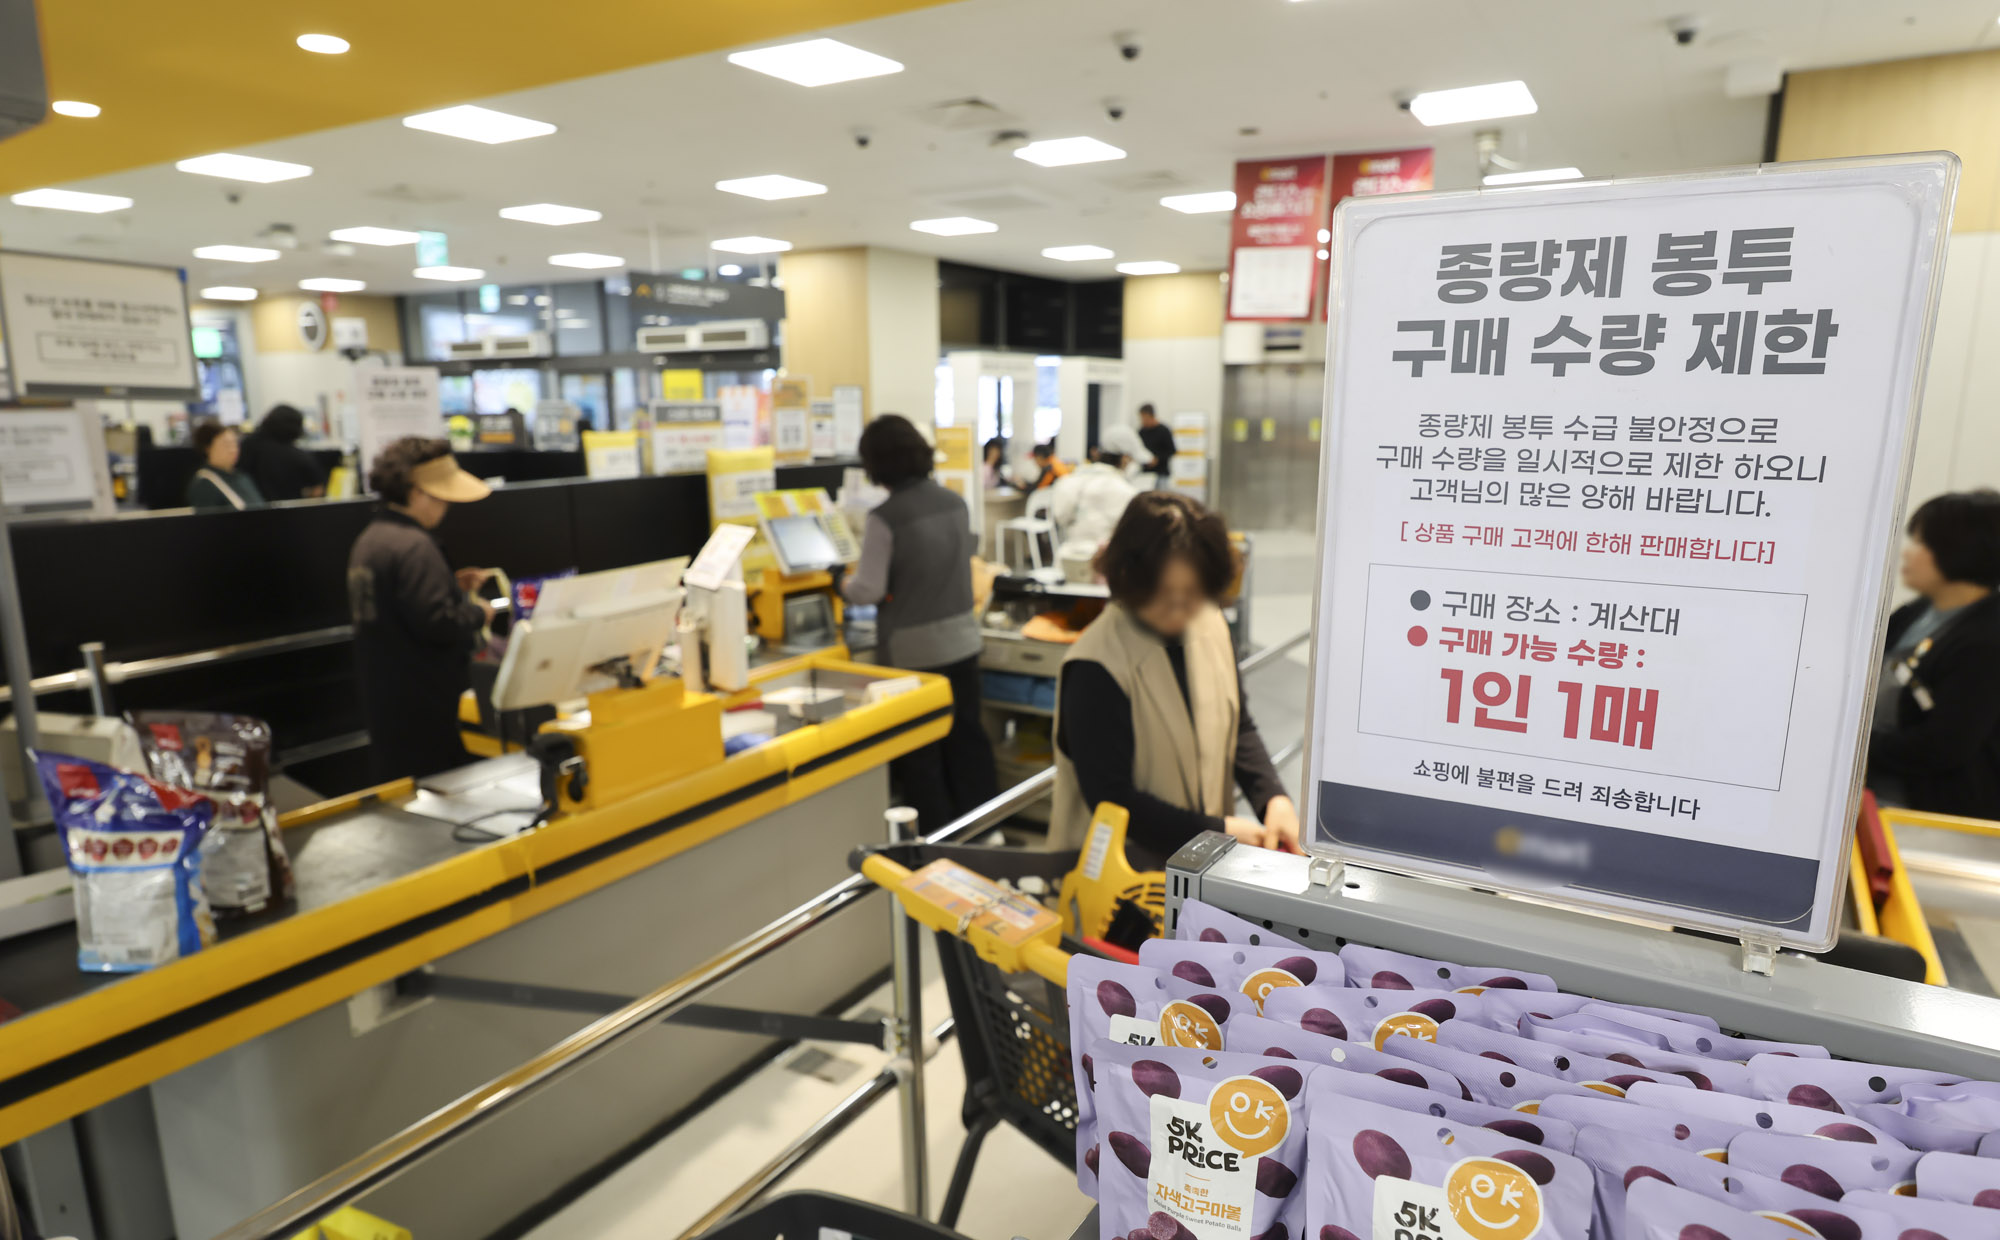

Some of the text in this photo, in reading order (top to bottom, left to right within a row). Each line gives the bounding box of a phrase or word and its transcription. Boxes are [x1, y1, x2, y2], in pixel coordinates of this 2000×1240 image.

[1437, 227, 1794, 304] 종량제 봉투
[1392, 309, 1839, 377] 구매 수량 제한
[1419, 414, 1778, 443] 종량제 봉투 수급 불안정으로
[1377, 446, 1826, 482] 구매 수량을 일시적으로 제한 하오니
[1411, 479, 1770, 517] 고객님의 많은 양해 바랍니다.
[1415, 523, 1455, 544] 상품
[1462, 525, 1504, 547] 구매
[1511, 528, 1578, 552] 고객에
[1586, 532, 1632, 555] 한해
[1640, 535, 1776, 565] 판매합니다]
[1442, 590, 1496, 620] 구매
[1506, 595, 1560, 624] 장소
[1588, 602, 1680, 636] 계산대
[1439, 626, 1493, 657] 구매
[1502, 632, 1558, 662] 가능
[1567, 639, 1629, 669] 수량
[1440, 668, 1660, 750] 1인 1매
[1413, 759, 1701, 820] 쇼핑에 불편을 드려 죄송합니다
[1230, 1091, 1275, 1120] OK
[1167, 1116, 1203, 1143] 5K
[1155, 1183, 1242, 1222] 자색고구마볼
[1471, 1174, 1523, 1209] OK
[1167, 1206, 1185, 1220] Purple
[1185, 1215, 1204, 1225] Sweet
[1205, 1219, 1226, 1229] Potato
[1226, 1224, 1242, 1232] Balls
[1394, 1201, 1441, 1233] 5K
